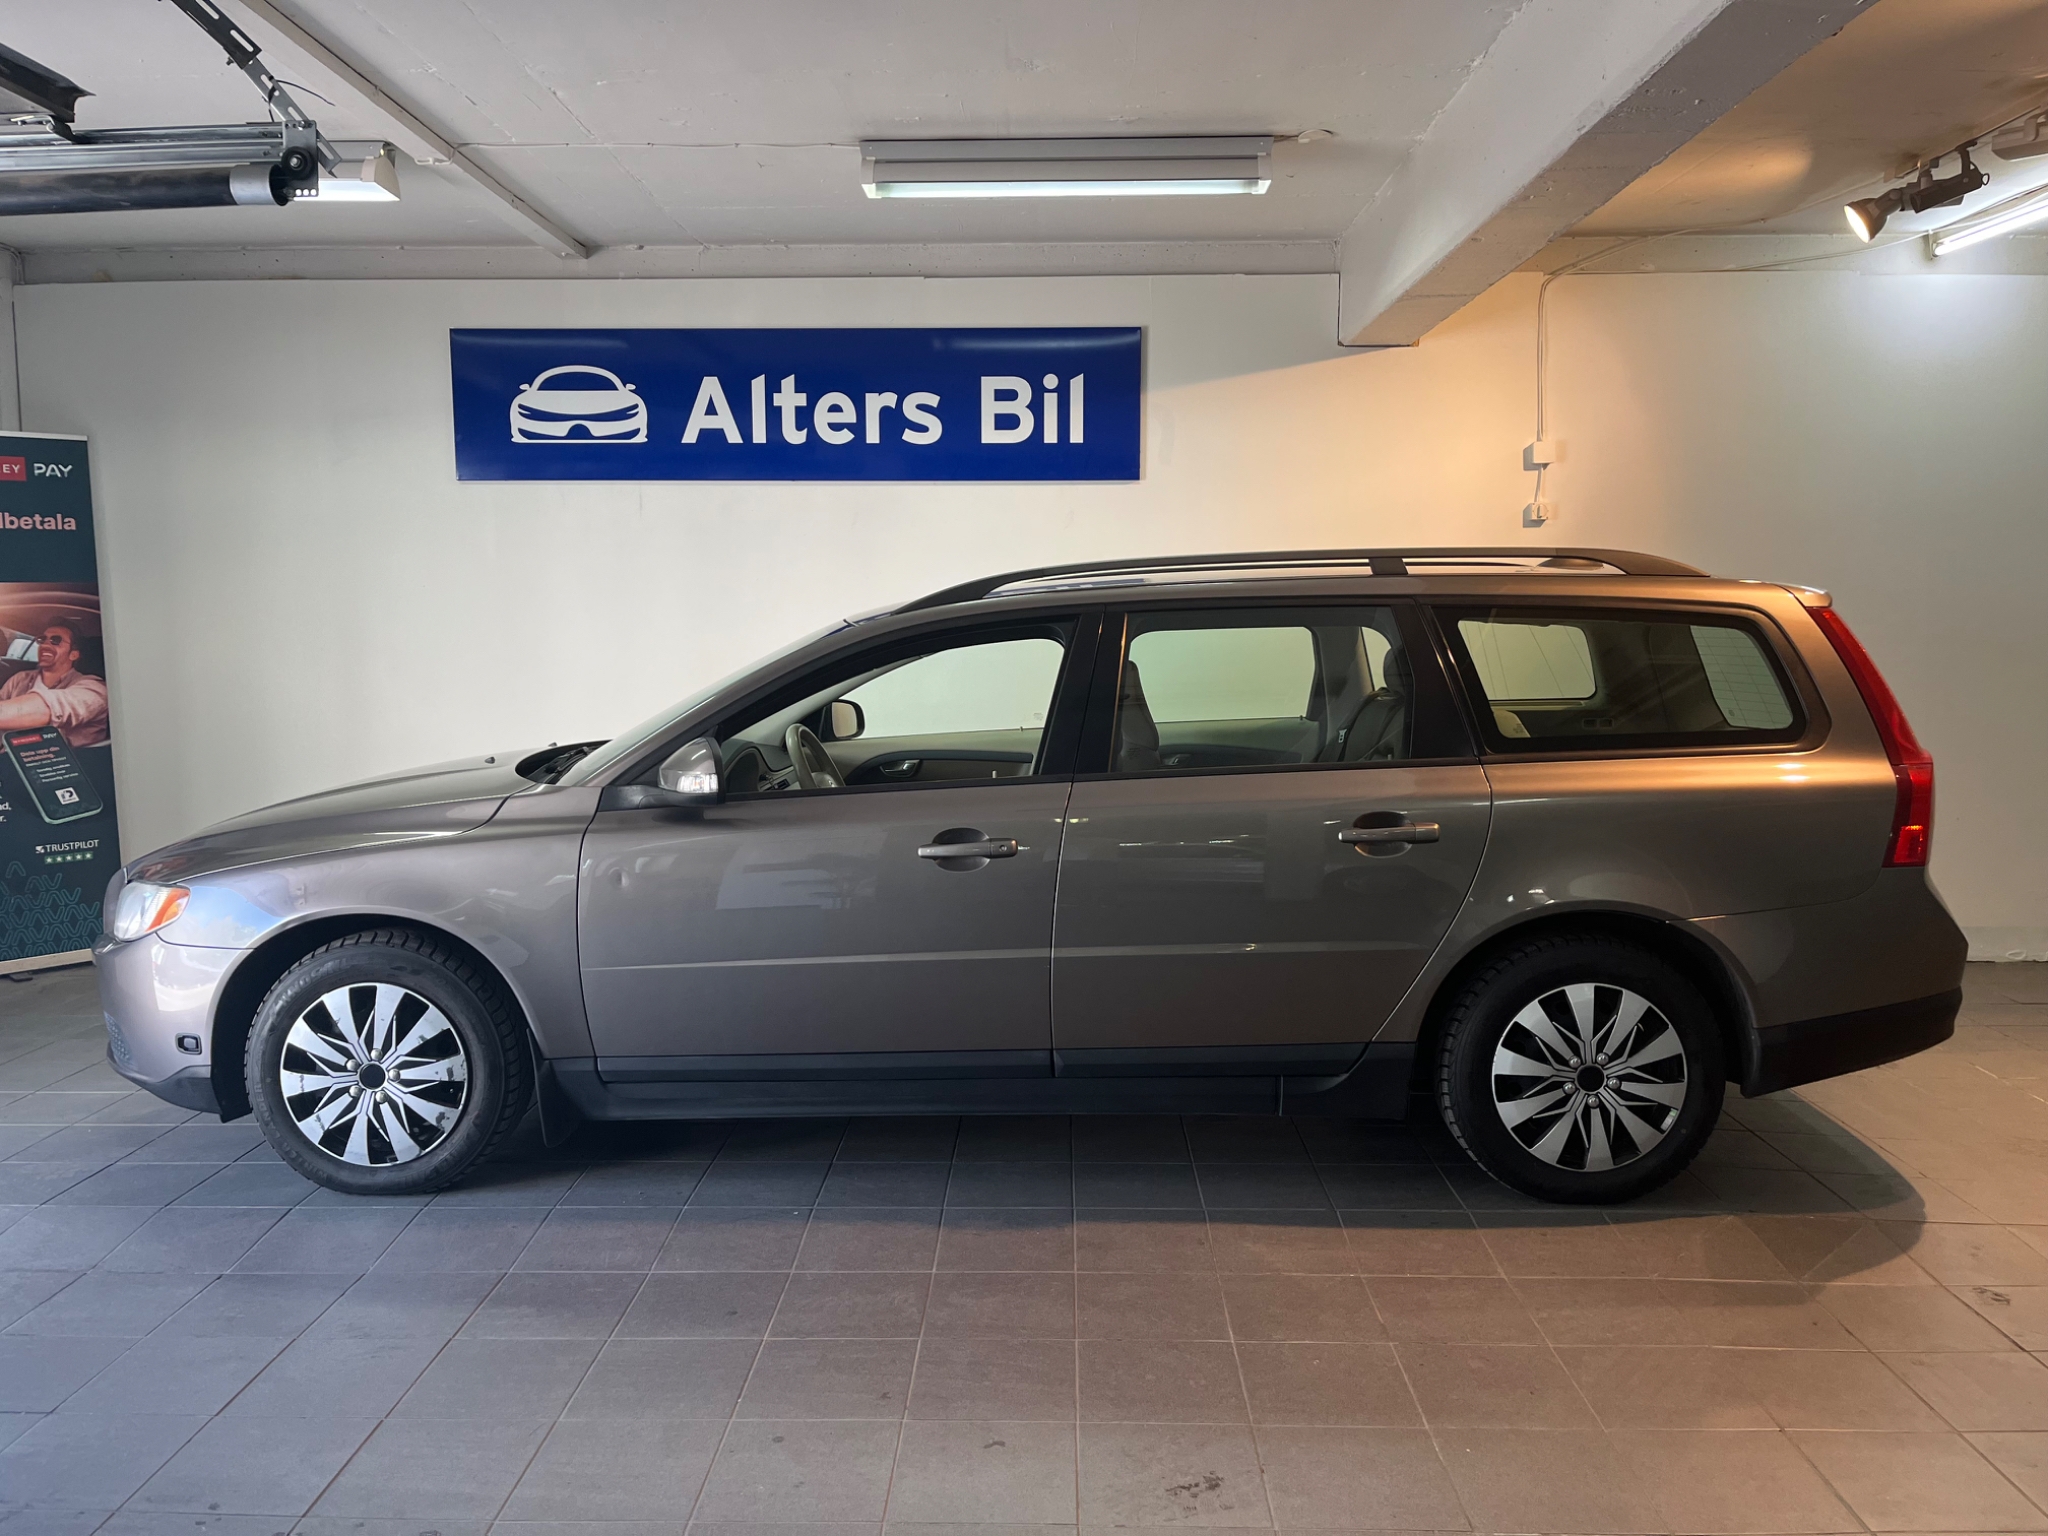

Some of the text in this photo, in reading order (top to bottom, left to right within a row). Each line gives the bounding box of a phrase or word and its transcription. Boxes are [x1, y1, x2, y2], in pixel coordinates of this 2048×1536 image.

[681, 373, 1085, 445] Alters Bil
[0, 463, 73, 477] EY PAY
[45, 839, 100, 852] TRUSTPILOT
